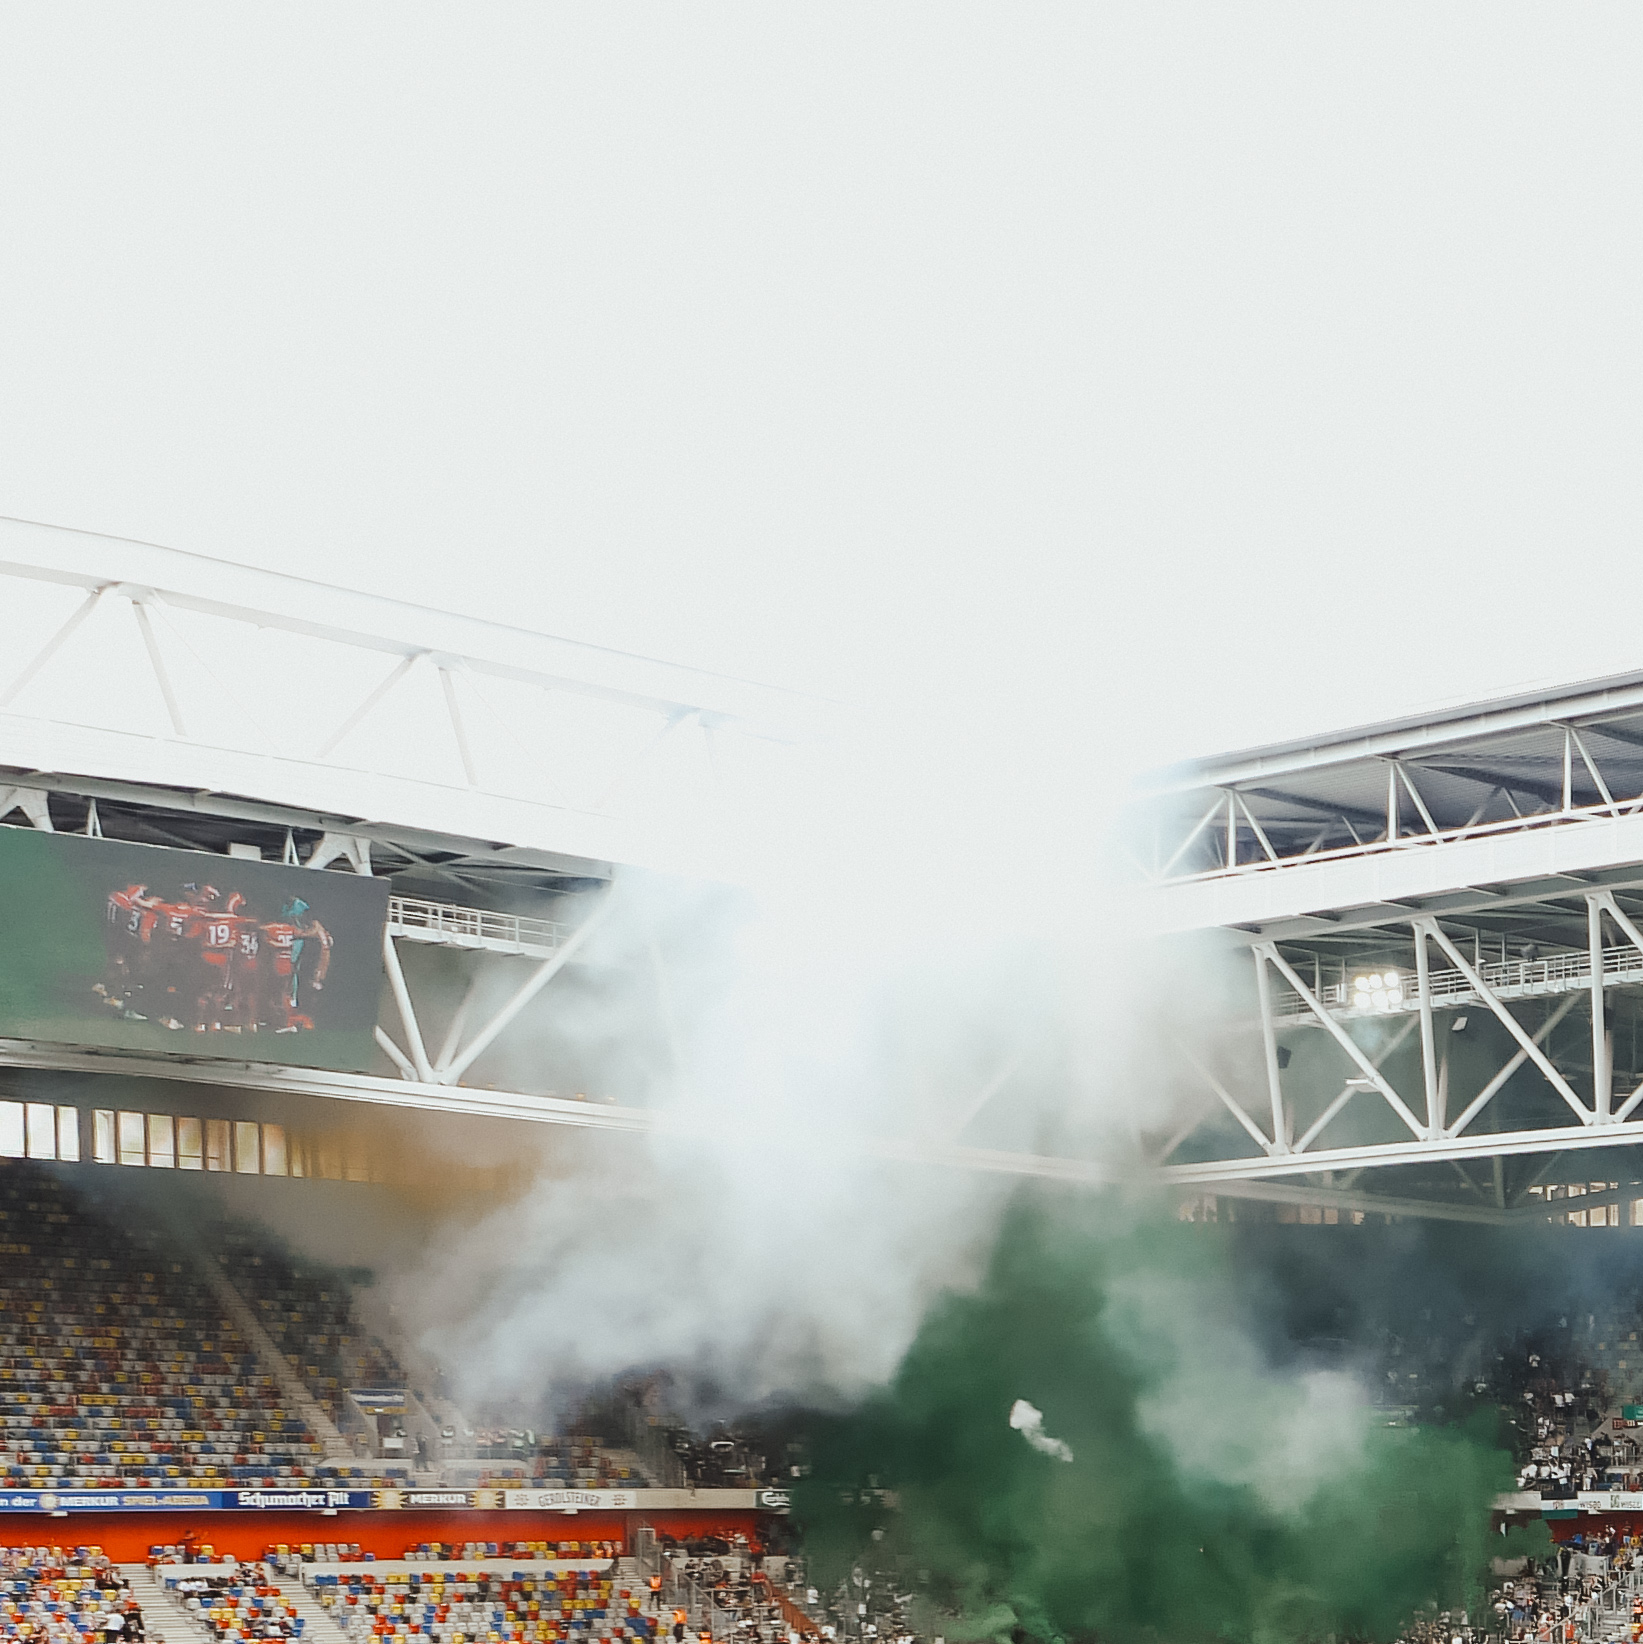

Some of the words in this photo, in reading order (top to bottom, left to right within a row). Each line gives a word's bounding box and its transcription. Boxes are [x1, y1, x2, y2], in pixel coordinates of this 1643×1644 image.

[208, 923, 229, 945] 19
[60, 1496, 119, 1508] MERKUR
[410, 1493, 467, 1505] MERKUR
